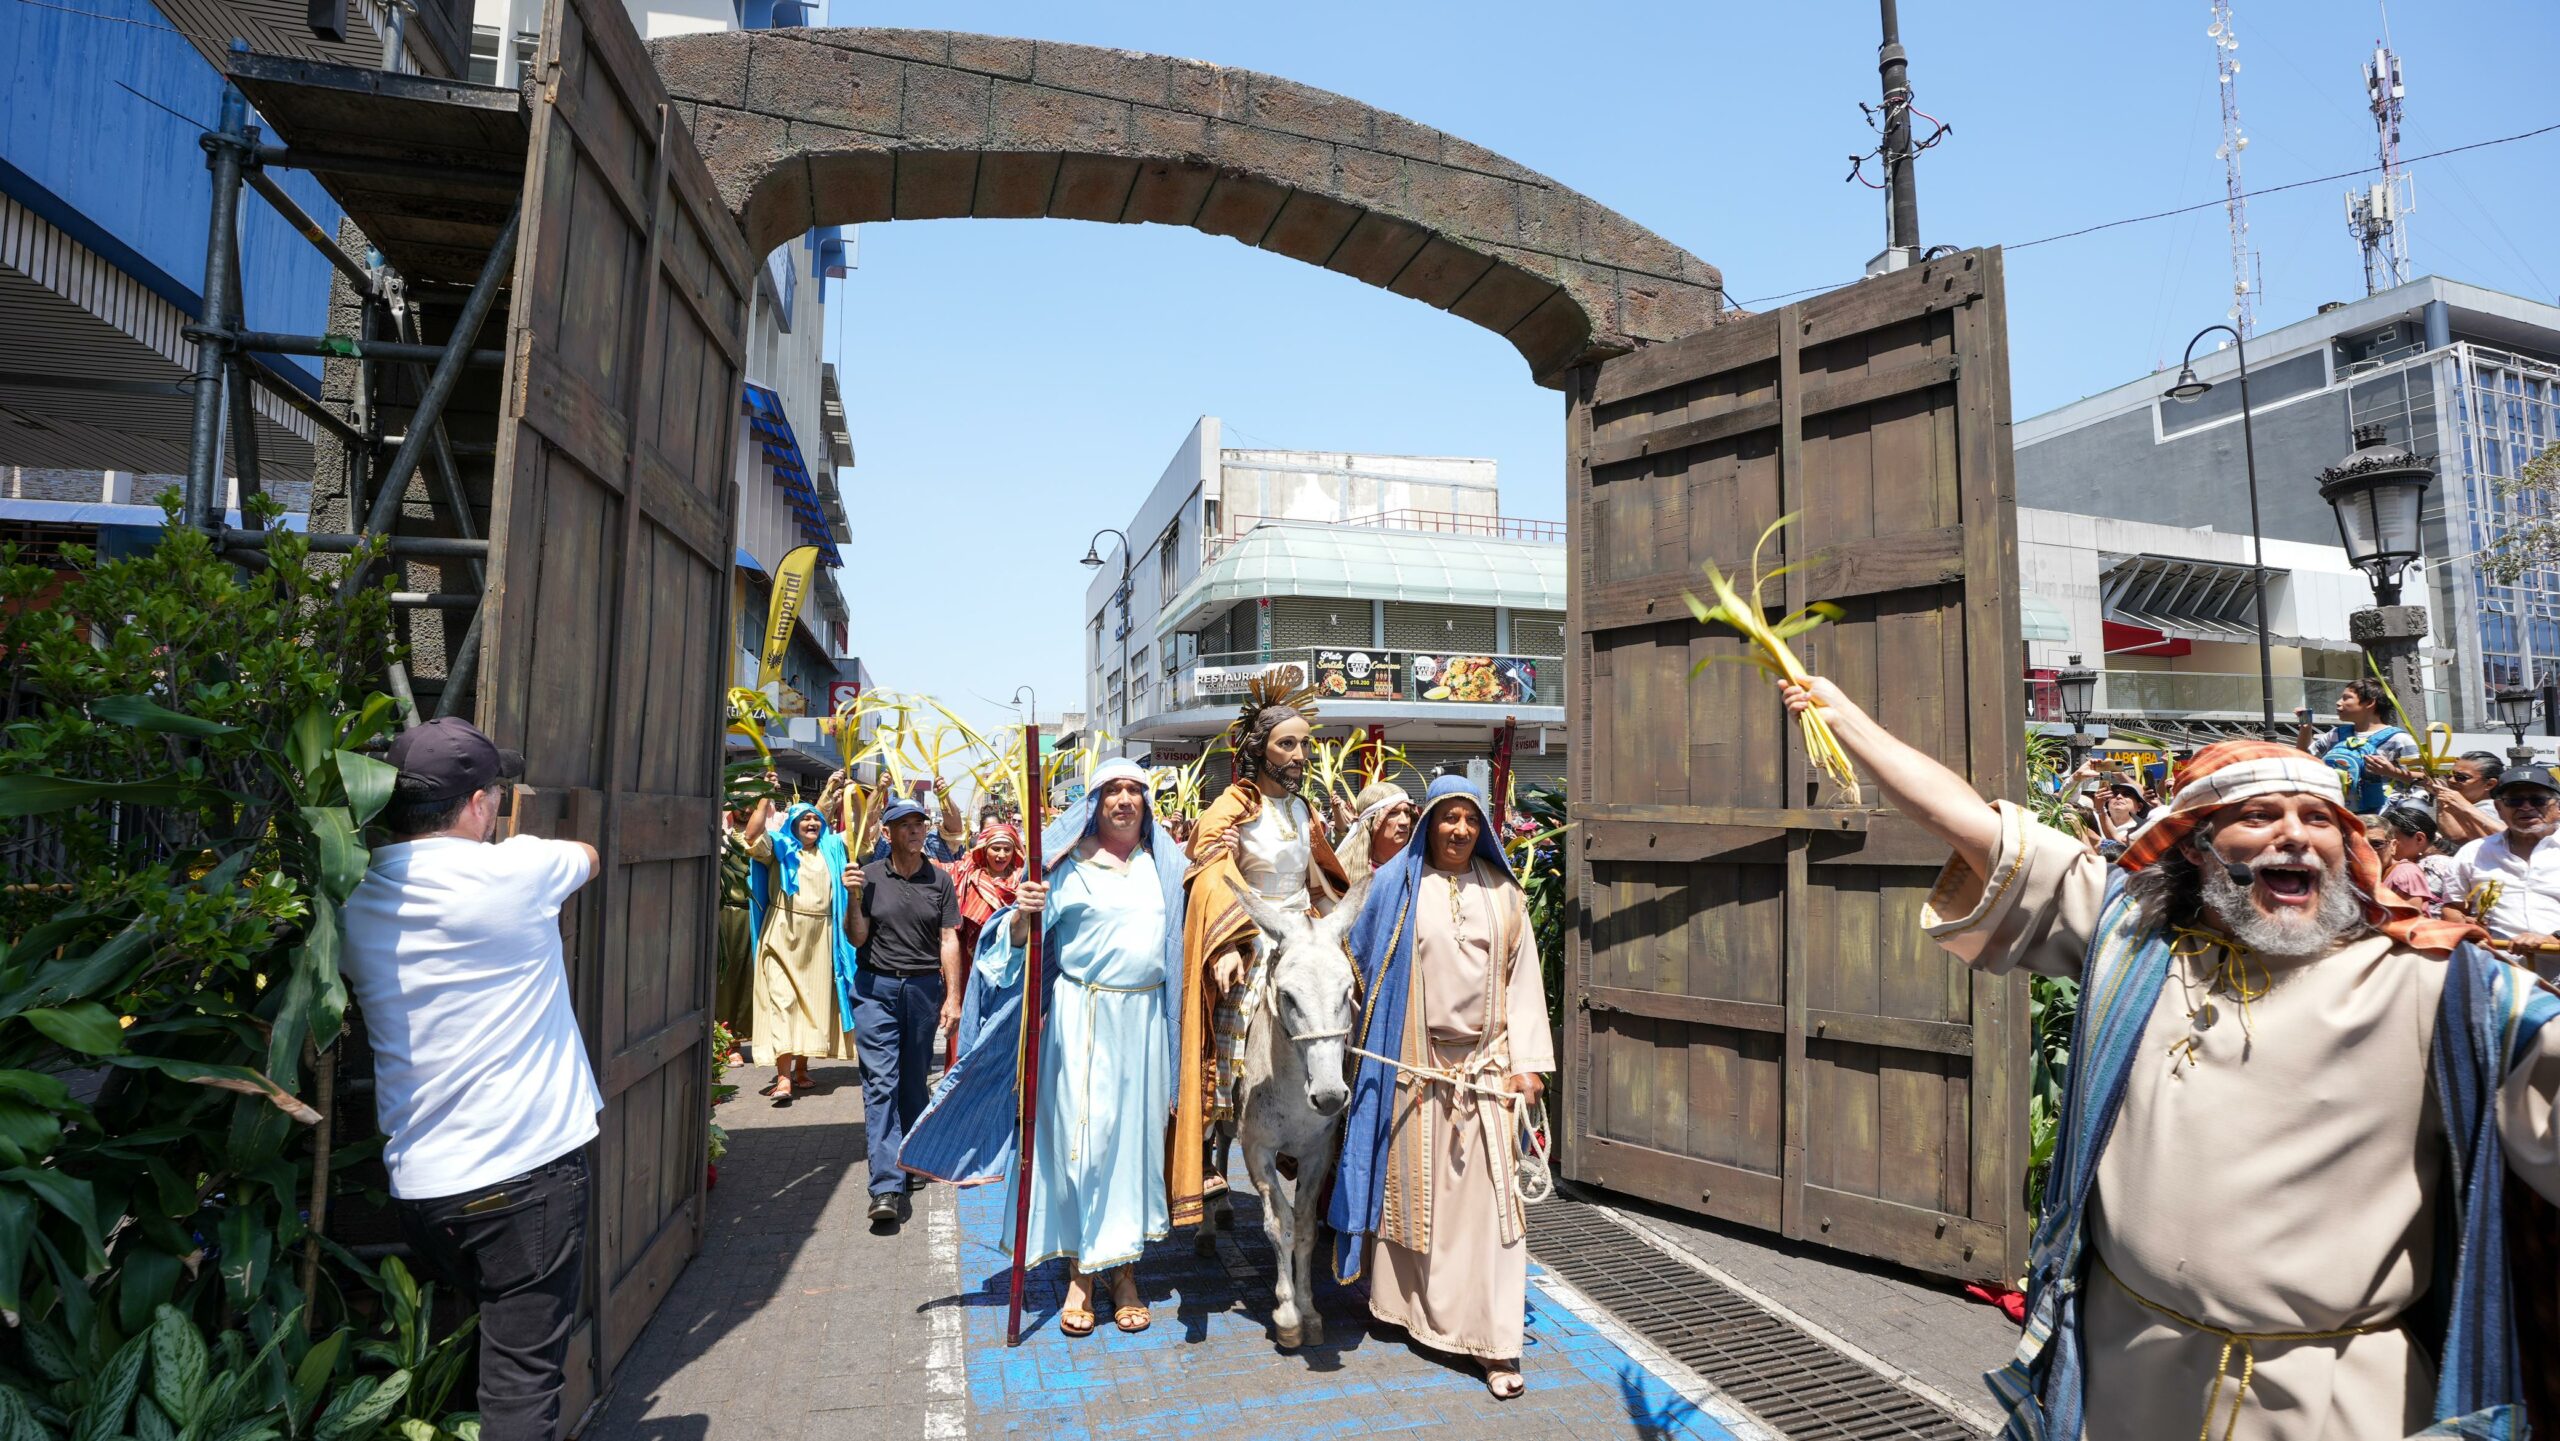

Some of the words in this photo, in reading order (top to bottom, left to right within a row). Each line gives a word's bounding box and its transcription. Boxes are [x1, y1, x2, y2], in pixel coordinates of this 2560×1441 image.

[771, 571, 802, 641] Imperial
[1198, 671, 1267, 684] RESTAURAN
[1520, 740, 1539, 750] VISION
[1163, 752, 1198, 761] VISION
